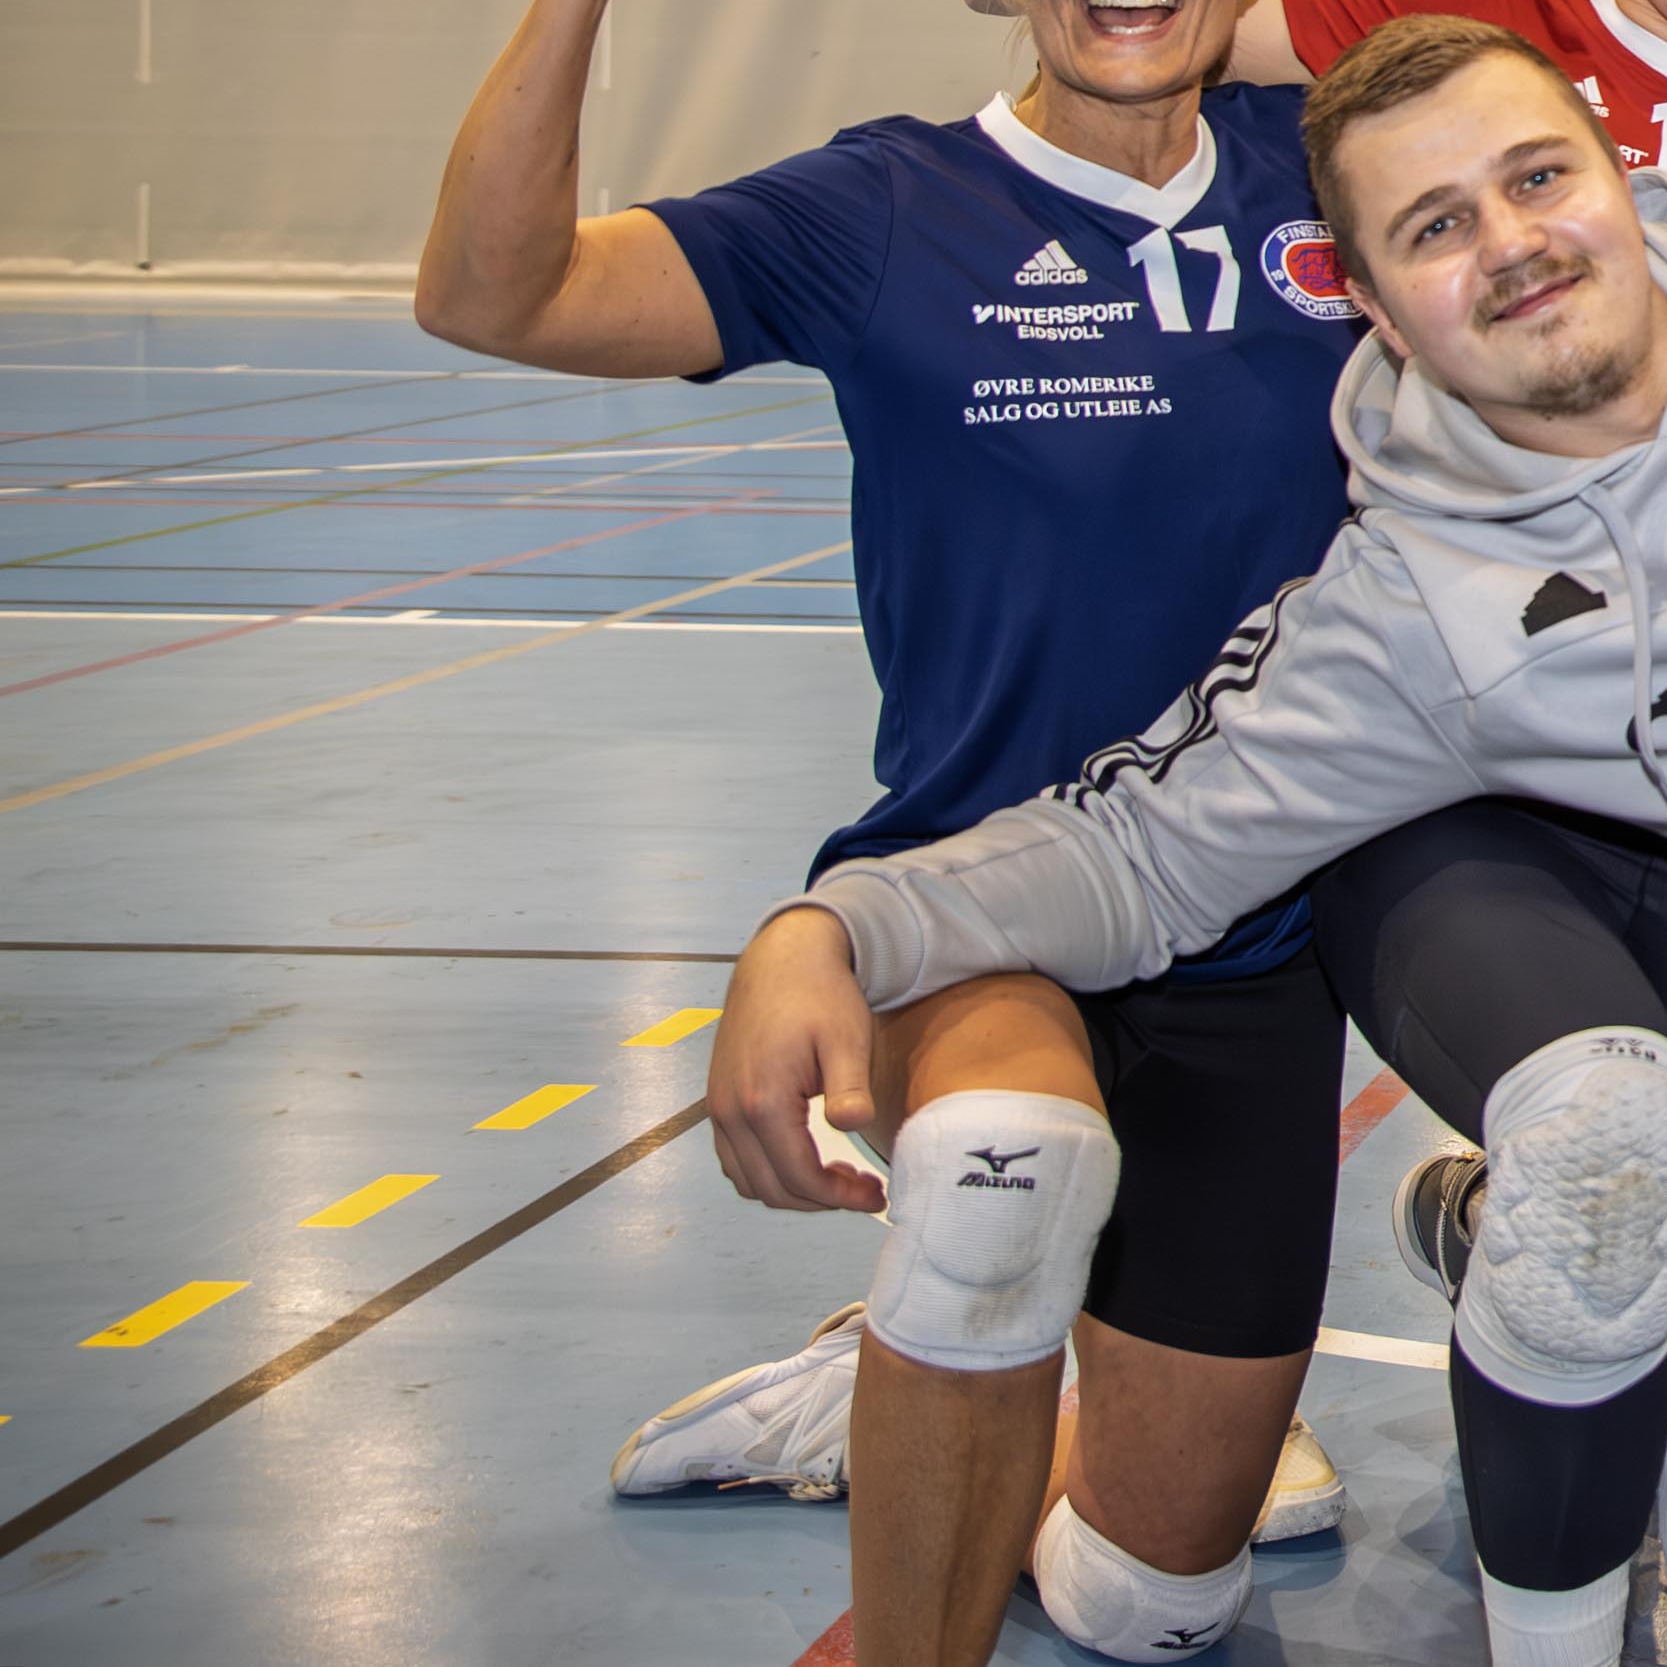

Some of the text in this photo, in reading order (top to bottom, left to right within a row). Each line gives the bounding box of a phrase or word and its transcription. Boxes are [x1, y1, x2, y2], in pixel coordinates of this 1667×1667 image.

[1015, 267, 1088, 286] adidas
[1126, 225, 1241, 332] 17
[1284, 285, 1358, 315] SPORTSKL
[996, 301, 1139, 324] INTERSPORT
[1017, 324, 1104, 341] EIDSVOLL
[973, 375, 1155, 398] ØVRE ROMERIKE
[964, 397, 1172, 424] SALG OG UTLEIE AS
